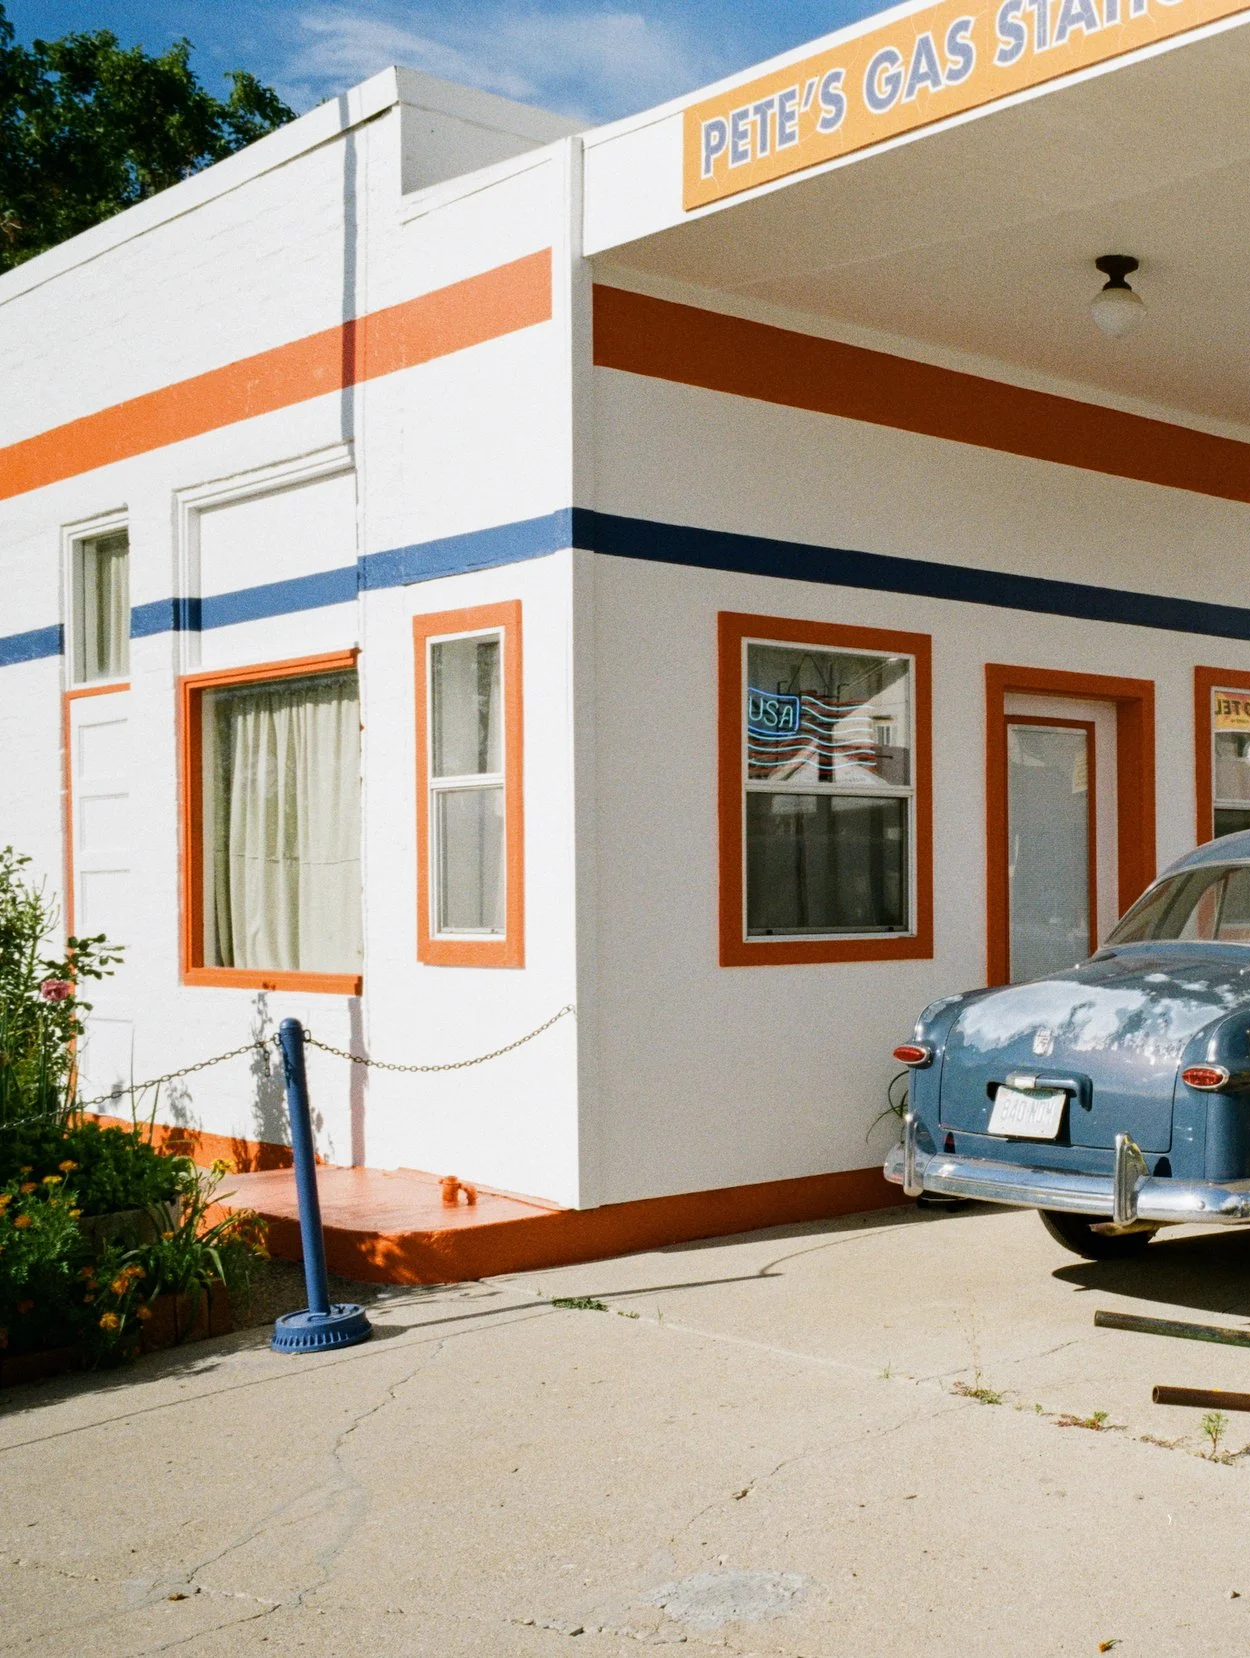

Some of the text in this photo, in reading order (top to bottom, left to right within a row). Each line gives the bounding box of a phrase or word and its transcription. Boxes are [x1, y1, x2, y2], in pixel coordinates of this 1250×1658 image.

[702, 0, 1185, 179] PETE'S GAS STA
[749, 696, 793, 728] USA
